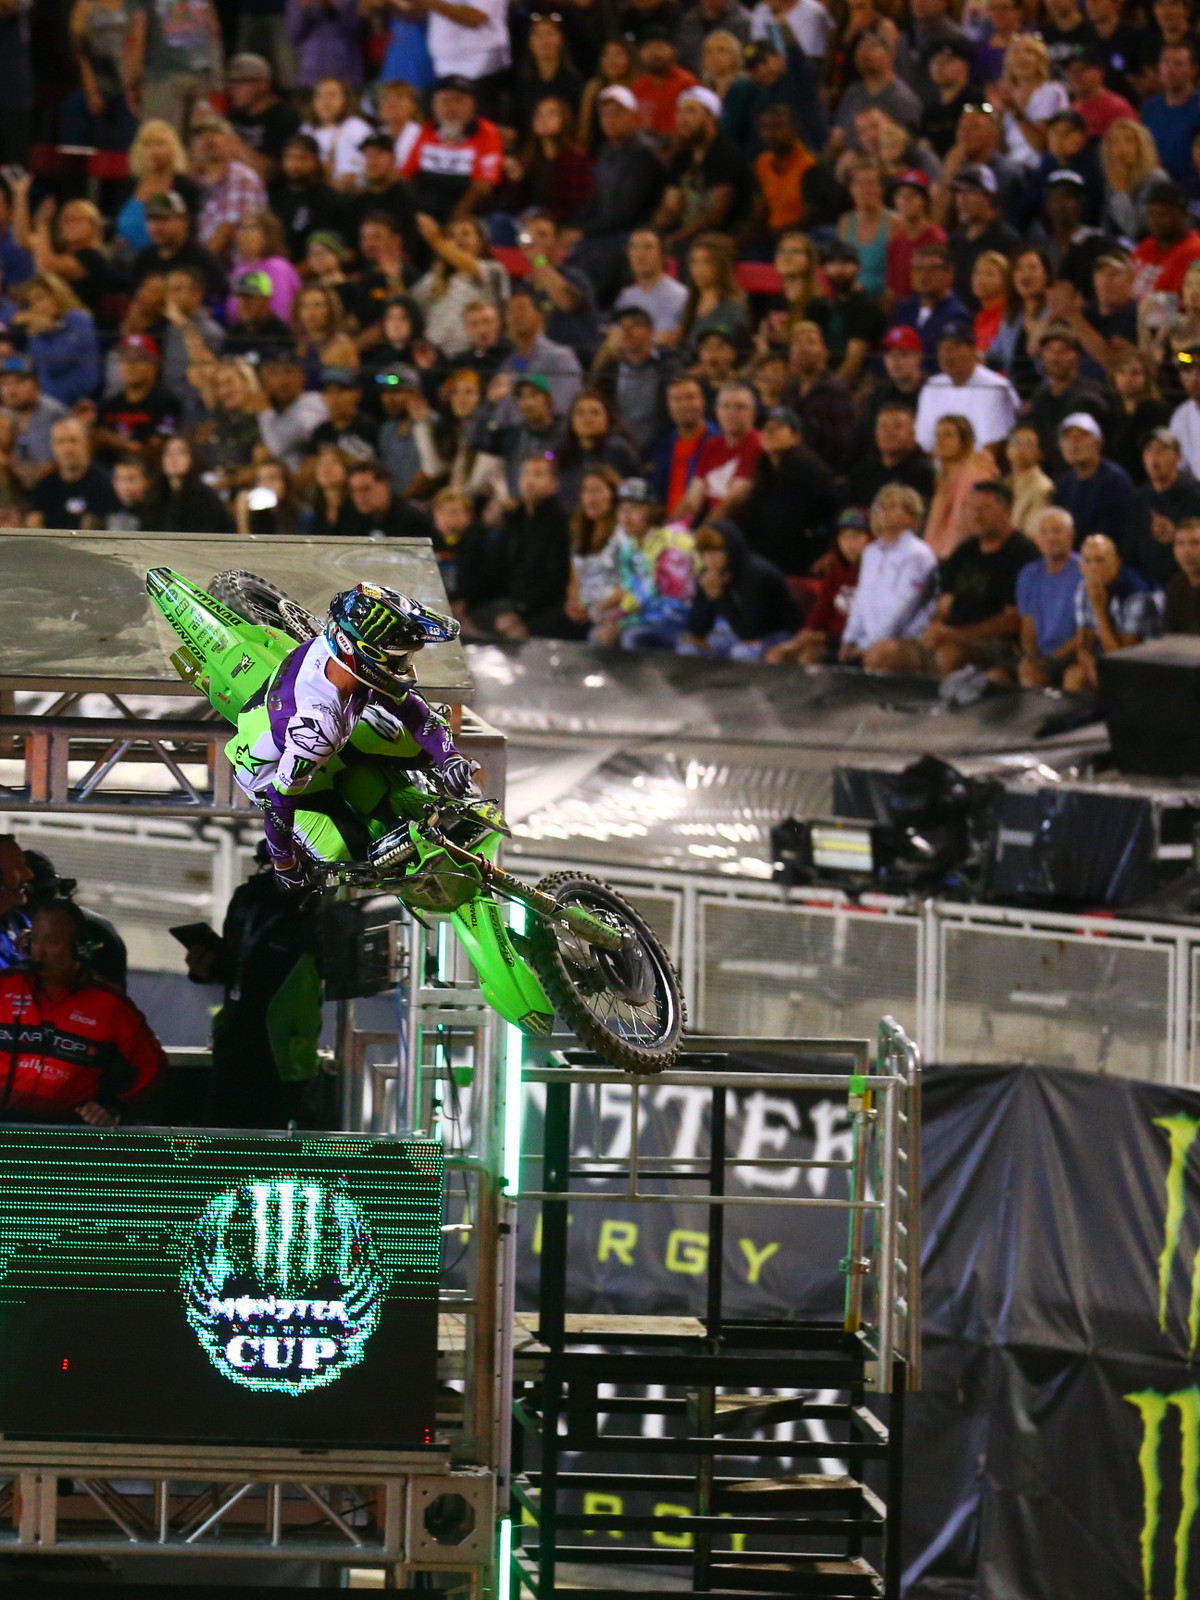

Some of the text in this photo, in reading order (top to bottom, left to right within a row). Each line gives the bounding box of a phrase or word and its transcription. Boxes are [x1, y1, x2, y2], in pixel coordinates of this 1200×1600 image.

[164, 612, 208, 664] DUNLOP
[338, 635, 351, 652] BELL
[372, 841, 411, 867] RENTHAL
[206, 1294, 348, 1322] MONSTER
[225, 1335, 337, 1370] CUP
